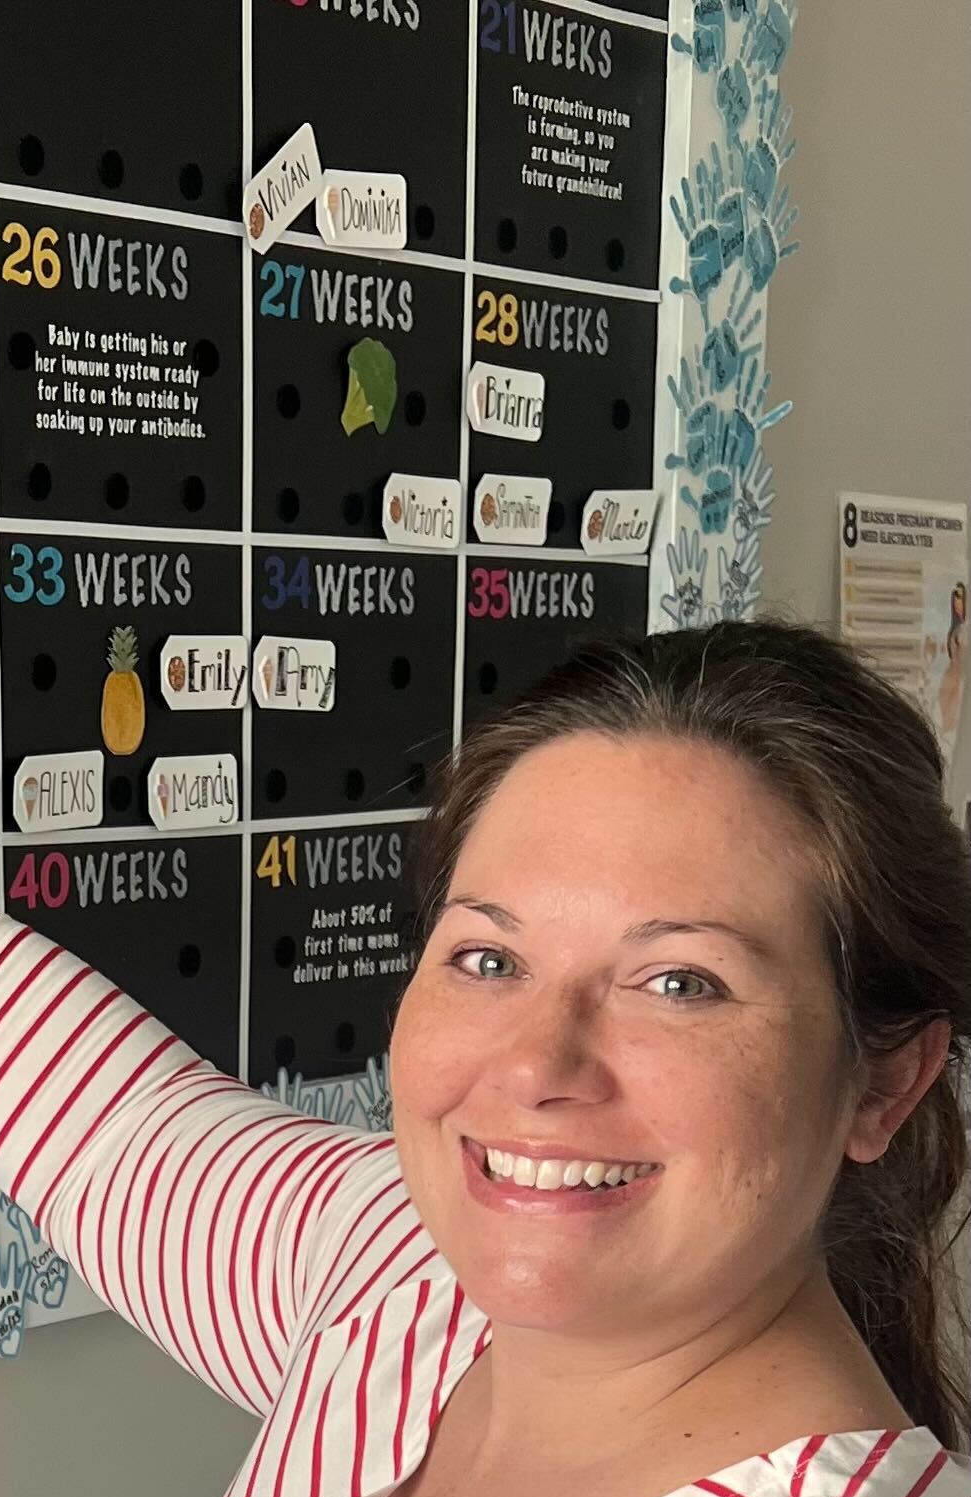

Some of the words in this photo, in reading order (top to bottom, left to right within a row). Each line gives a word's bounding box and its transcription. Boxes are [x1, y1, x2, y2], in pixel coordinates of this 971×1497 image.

[480, 1, 516, 55] 21
[523, 8, 612, 78] WEEKS
[512, 85, 529, 106] The
[533, 94, 593, 120] reproductive
[597, 108, 630, 128] system
[528, 114, 536, 134] is
[540, 116, 581, 145] forming,
[584, 131, 594, 145] so
[598, 133, 614, 150] you
[521, 163, 553, 188] future
[556, 176, 622, 200] grandchildren!
[531, 146, 548, 162] are
[551, 147, 585, 172] making
[589, 156, 610, 174] your
[2, 222, 61, 289] 26
[68, 232, 188, 300] WEEKS
[260, 260, 305, 319] 27
[310, 268, 414, 332] WEEKS
[48, 323, 80, 350] Baby
[85, 330, 95, 349] is
[101, 331, 147, 357] getting
[150, 332, 168, 356] his
[173, 340, 187, 357] or
[475, 290, 519, 346] 28
[522, 299, 609, 356] WEEKS
[35, 351, 57, 372] her
[62, 354, 110, 377] immune
[115, 361, 160, 382] system
[164, 365, 199, 388] ready
[37, 378, 58, 401] for
[64, 381, 85, 403] life
[91, 388, 105, 404] on
[111, 385, 132, 407] the
[136, 390, 179, 410] outside
[184, 391, 199, 414] by
[36, 408, 84, 434] soaking
[89, 414, 103, 436] up
[108, 416, 136, 436] your
[141, 417, 206, 439] antibodies.
[402, 488, 453, 540] Victoria
[843, 503, 857, 548] 8
[861, 510, 895, 525] REASONS
[3, 543, 65, 605] 33
[74, 552, 192, 608] WEEKS
[261, 556, 311, 610] 34
[315, 563, 416, 616] WEEKS
[467, 567, 511, 619] 35
[508, 570, 594, 619] WEEKS
[187, 648, 248, 707] Emily
[275, 646, 336, 708] Amy
[38, 769, 96, 819] ALEXIS
[172, 760, 235, 824] Mandy
[9, 852, 69, 909] 40
[74, 847, 187, 908] WEEKS
[256, 835, 297, 888] 41
[304, 832, 402, 888] WEEKS
[312, 908, 346, 929] About
[350, 903, 376, 926] 50%
[379, 901, 392, 922] of
[293, 963, 333, 983] deliver
[337, 959, 348, 979] in
[353, 956, 375, 977] this
[304, 935, 333, 957] first
[338, 933, 363, 953] time
[367, 933, 399, 949] moms
